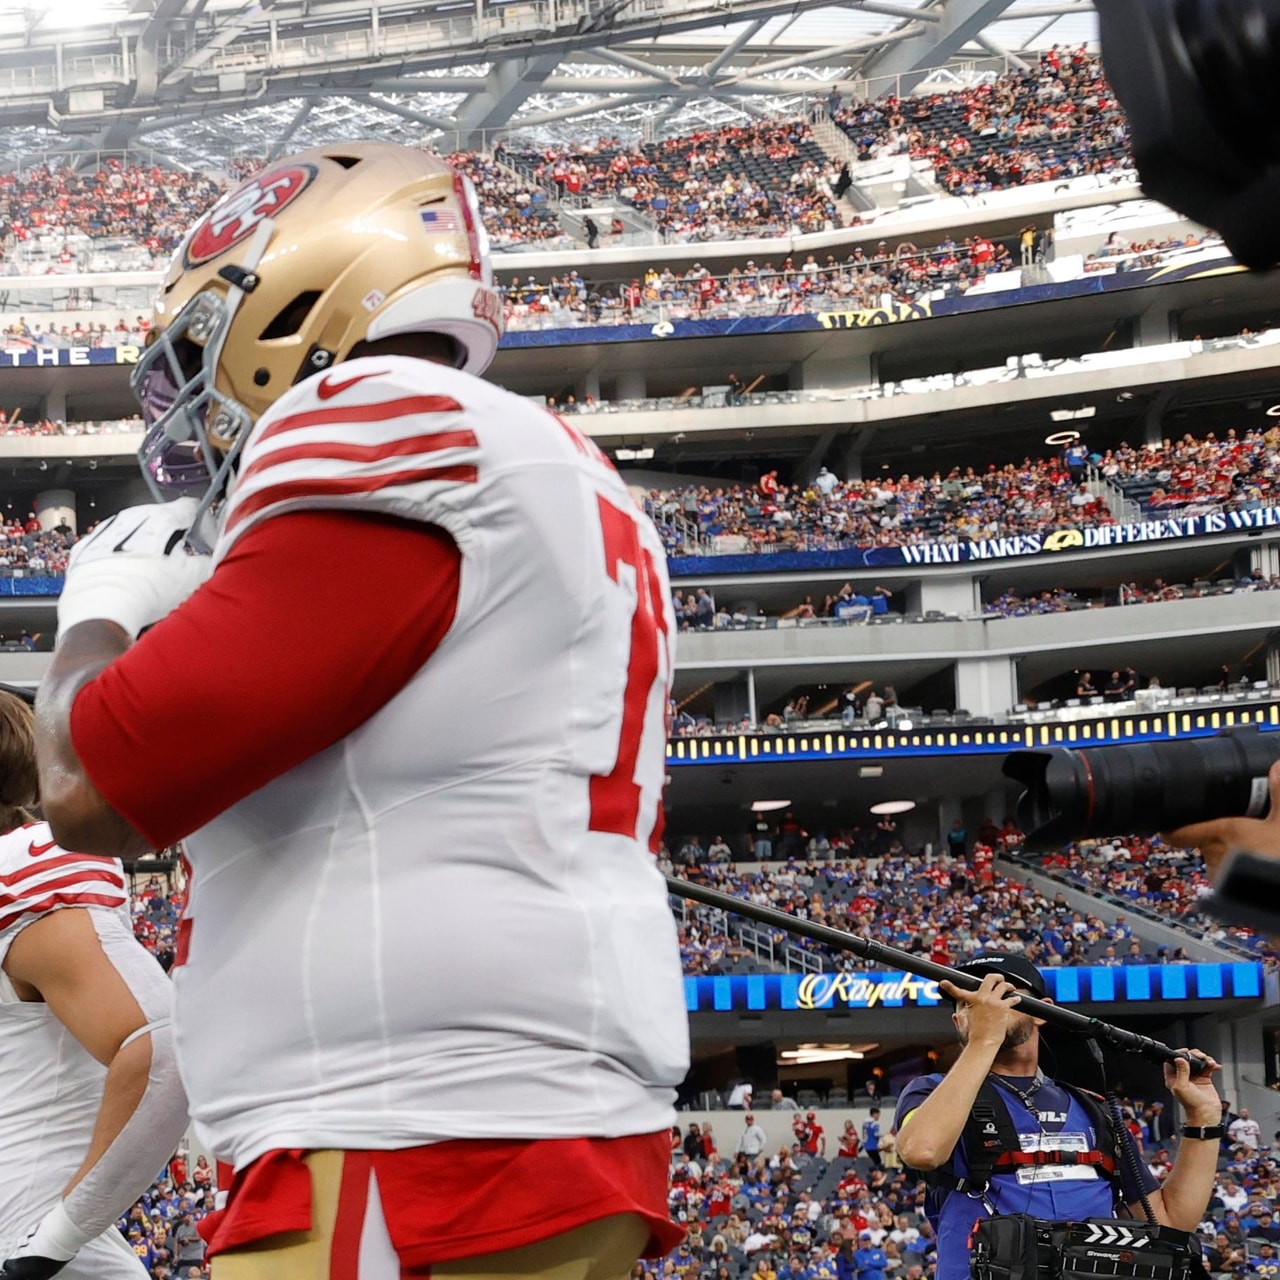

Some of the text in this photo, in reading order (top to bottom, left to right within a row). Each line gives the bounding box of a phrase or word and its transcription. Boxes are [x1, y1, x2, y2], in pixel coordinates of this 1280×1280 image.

[5, 346, 90, 366] THE
[900, 544, 963, 565] WHAT
[968, 534, 1042, 561] MAKES
[1083, 516, 1201, 548] DIFFERENT
[1204, 512, 1226, 533] IS
[796, 972, 910, 1009] Royal
